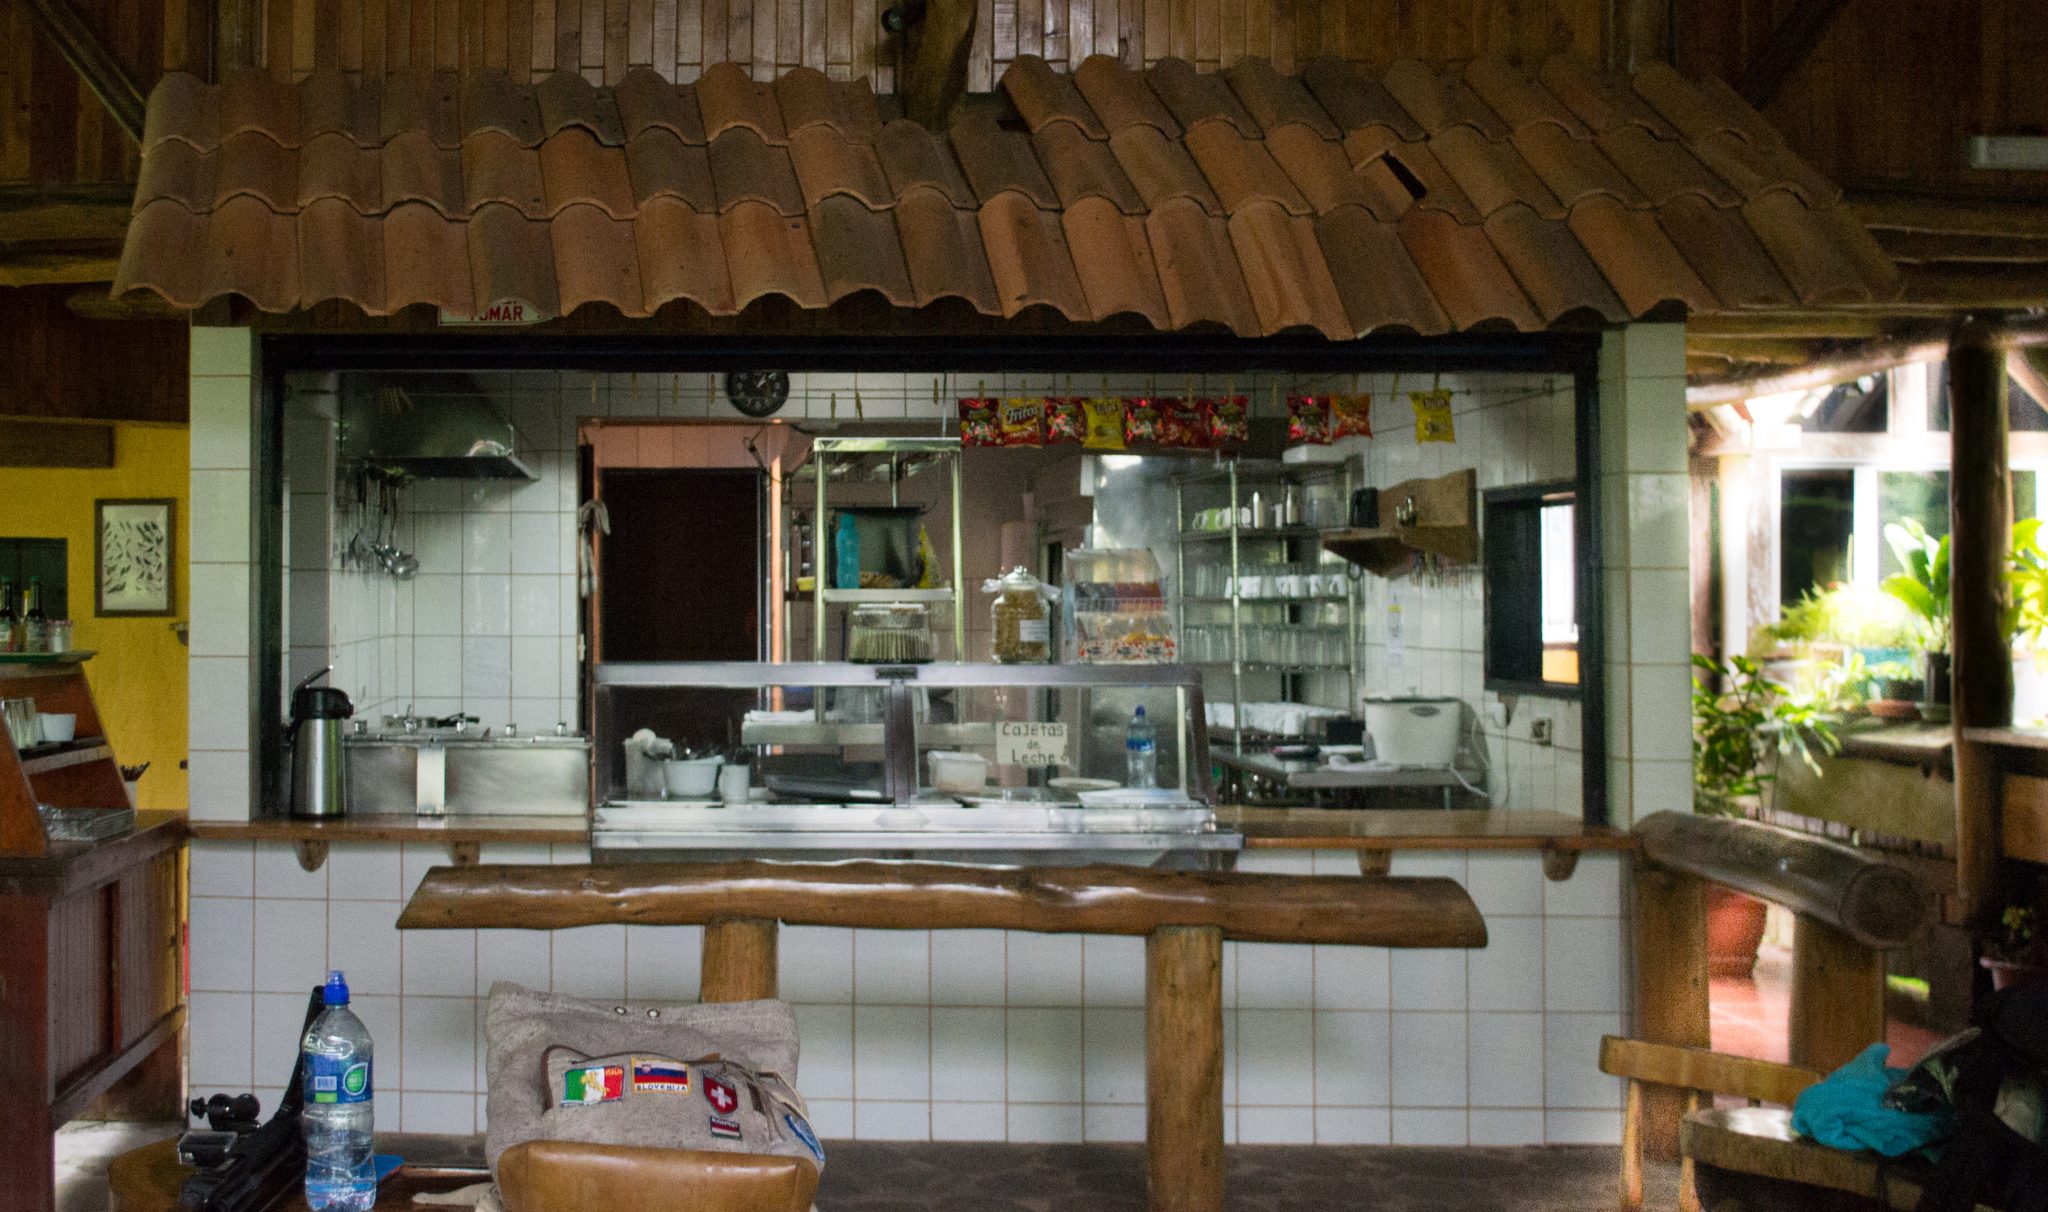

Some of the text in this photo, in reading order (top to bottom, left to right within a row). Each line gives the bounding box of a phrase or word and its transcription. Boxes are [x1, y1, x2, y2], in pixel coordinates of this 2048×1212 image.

[1027, 739, 1041, 750] de
[1012, 749, 1056, 763] Leche
[636, 1083, 687, 1091] SLOVENIJA
